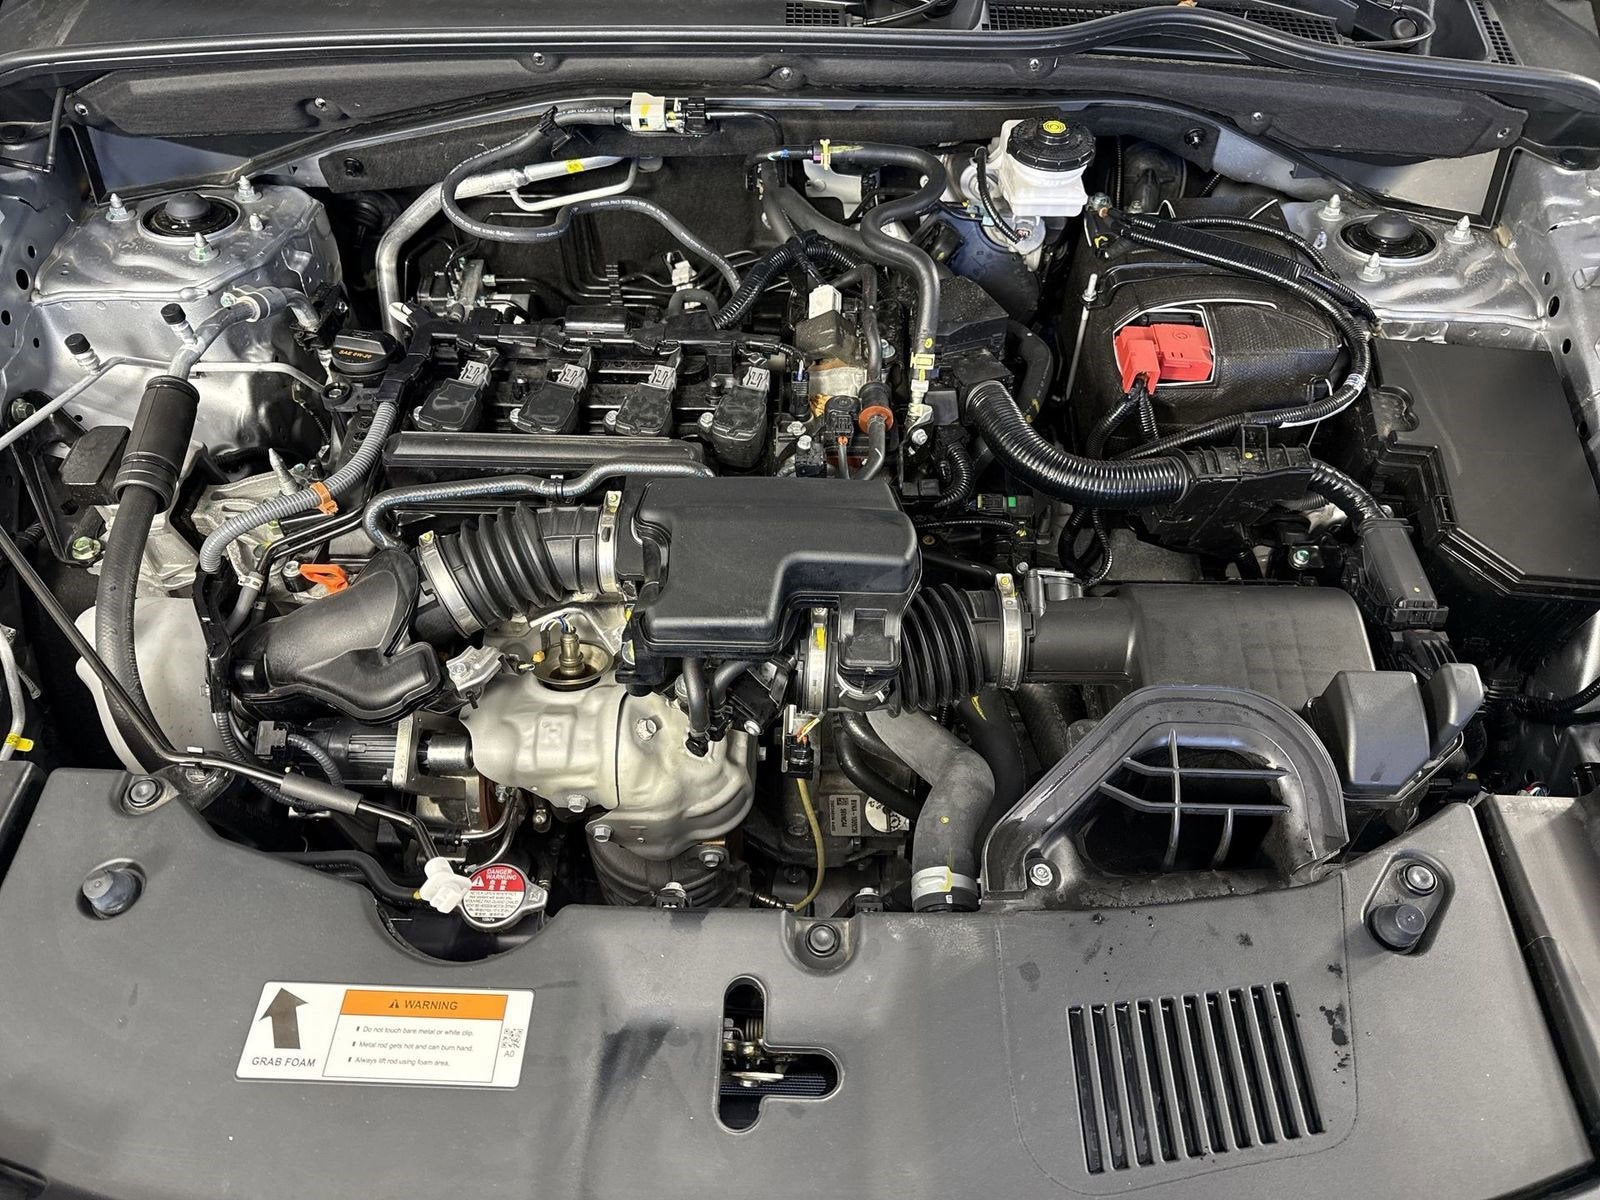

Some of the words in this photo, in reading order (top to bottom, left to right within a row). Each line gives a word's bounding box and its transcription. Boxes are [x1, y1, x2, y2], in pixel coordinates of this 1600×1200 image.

[404, 999, 459, 1011] WARNING
[362, 1025, 373, 1033] Do
[384, 1026, 401, 1034] touch
[461, 1029, 474, 1037] clip.
[359, 1040, 377, 1048] Metal
[388, 1042, 402, 1050] gets
[403, 1042, 415, 1050] hot
[456, 1044, 473, 1052] hand.
[503, 1050, 516, 1058] A0
[251, 1056, 282, 1066] GRAB
[284, 1057, 317, 1067] FOAM
[354, 1056, 377, 1065] Always
[387, 1057, 398, 1065] rod
[398, 1058, 416, 1067] using
